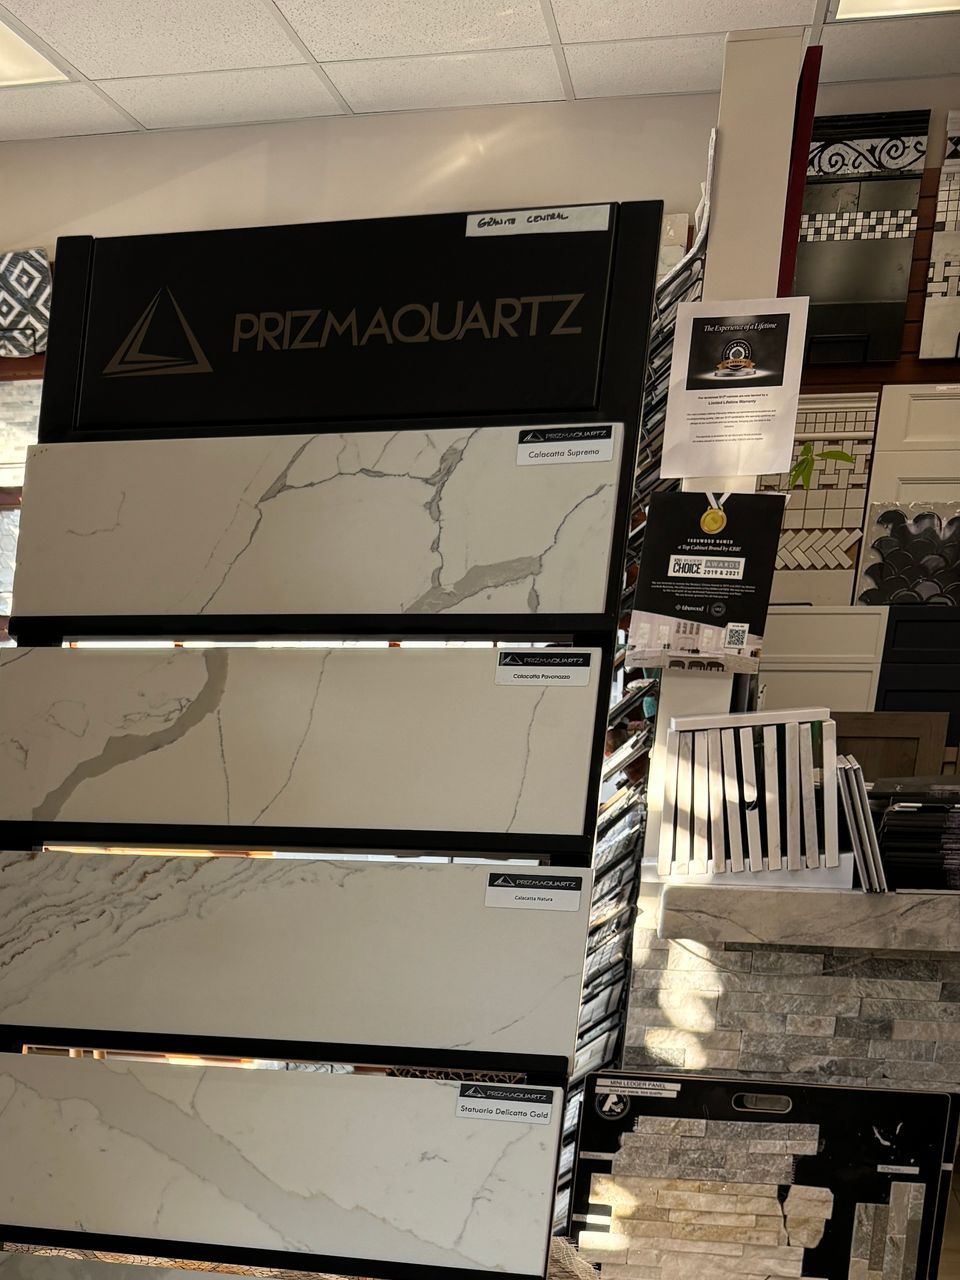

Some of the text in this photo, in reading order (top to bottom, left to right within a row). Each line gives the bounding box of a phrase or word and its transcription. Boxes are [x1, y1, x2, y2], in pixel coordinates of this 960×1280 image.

[526, 212, 569, 224] CENTRAL
[232, 293, 586, 352] PRIZMAQUARTZ
[703, 324, 714, 333] The
[714, 324, 743, 334] Experience
[545, 429, 607, 441] PRIZMAQUARTZ
[529, 448, 600, 459] Calacatta Supremo
[673, 562, 702, 574] CHOICE
[705, 561, 740, 569] AWARDS
[522, 656, 584, 665] PRIZMAQUARTZ
[513, 672, 571, 680] Calacatta Pavonazzo
[516, 879, 577, 888] PRIZMAQUARTZ
[487, 1090, 548, 1101] PRIZMAQUARTZ
[460, 1104, 494, 1115] Statuario
[529, 1110, 549, 1119] Gold
